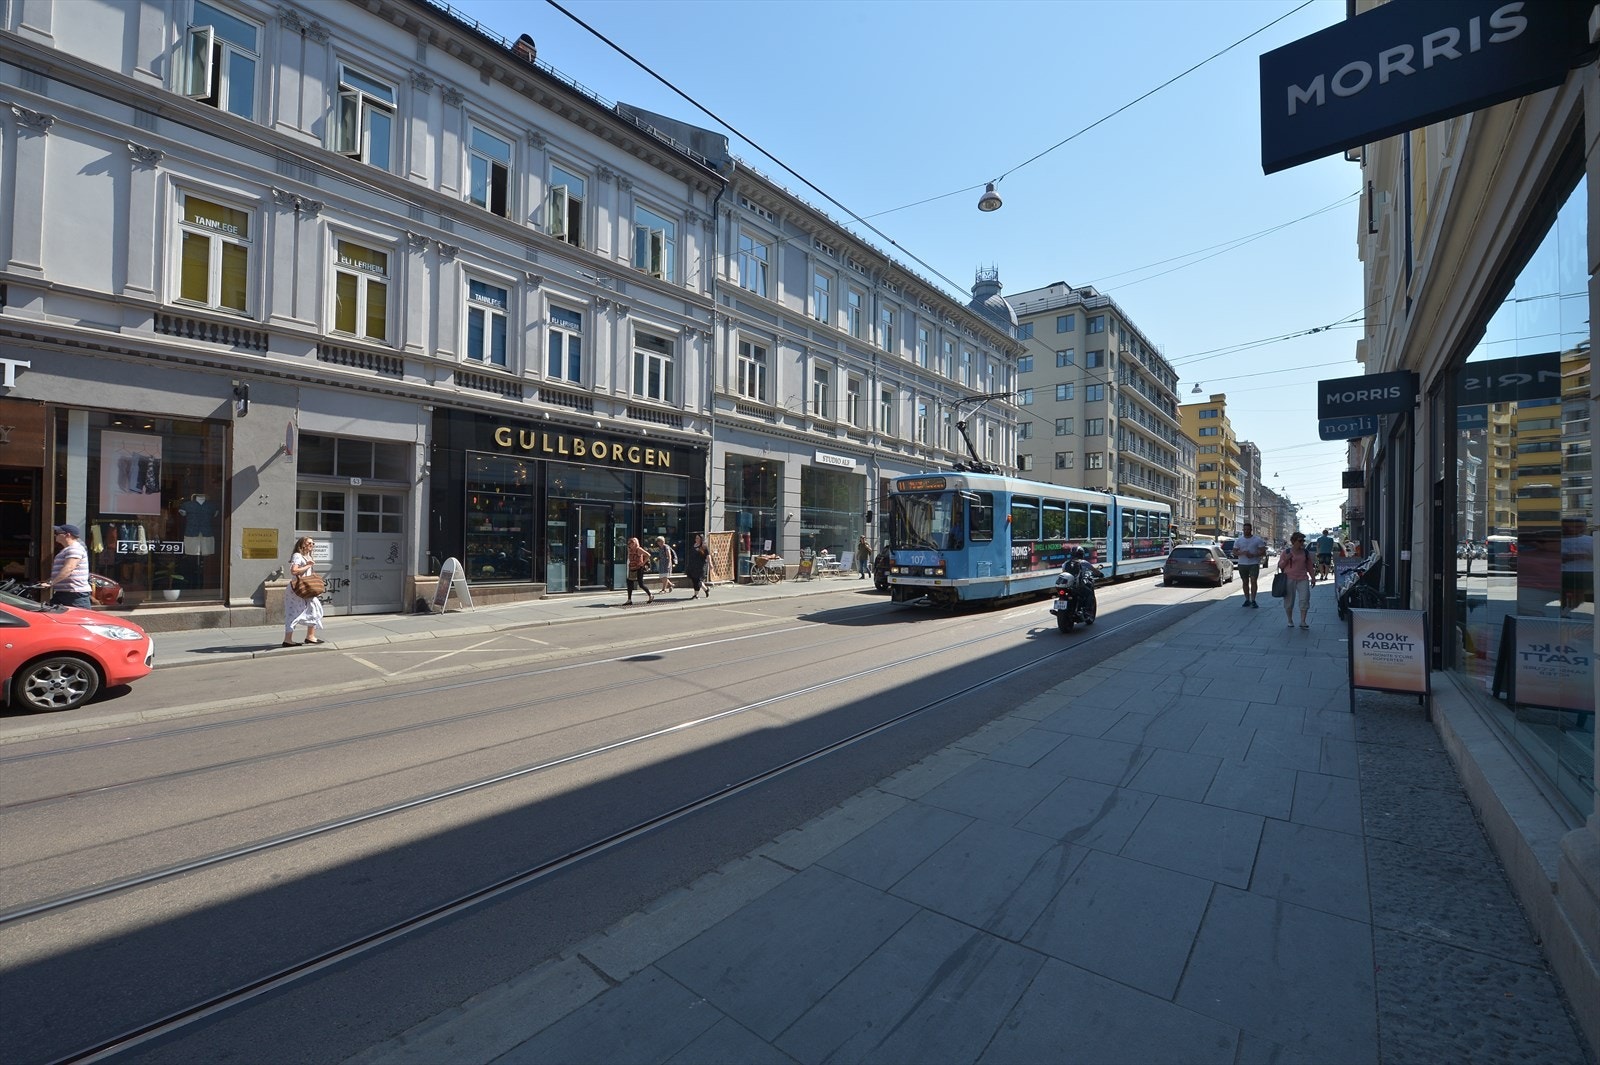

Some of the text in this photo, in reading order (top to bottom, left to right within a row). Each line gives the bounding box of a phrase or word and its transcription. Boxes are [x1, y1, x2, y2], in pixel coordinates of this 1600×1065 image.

[1287, 1, 1528, 117] MORRIS
[194, 214, 238, 234] TANNLEGE
[1326, 386, 1401, 405] MORRIS
[1325, 418, 1373, 433] norli
[494, 426, 671, 468] GULLBORGEN
[822, 455, 842, 465] STUDIO
[121, 543, 180, 552] 2 FOR 799
[911, 555, 925, 565] 107
[1362, 640, 1415, 652] RABATT
